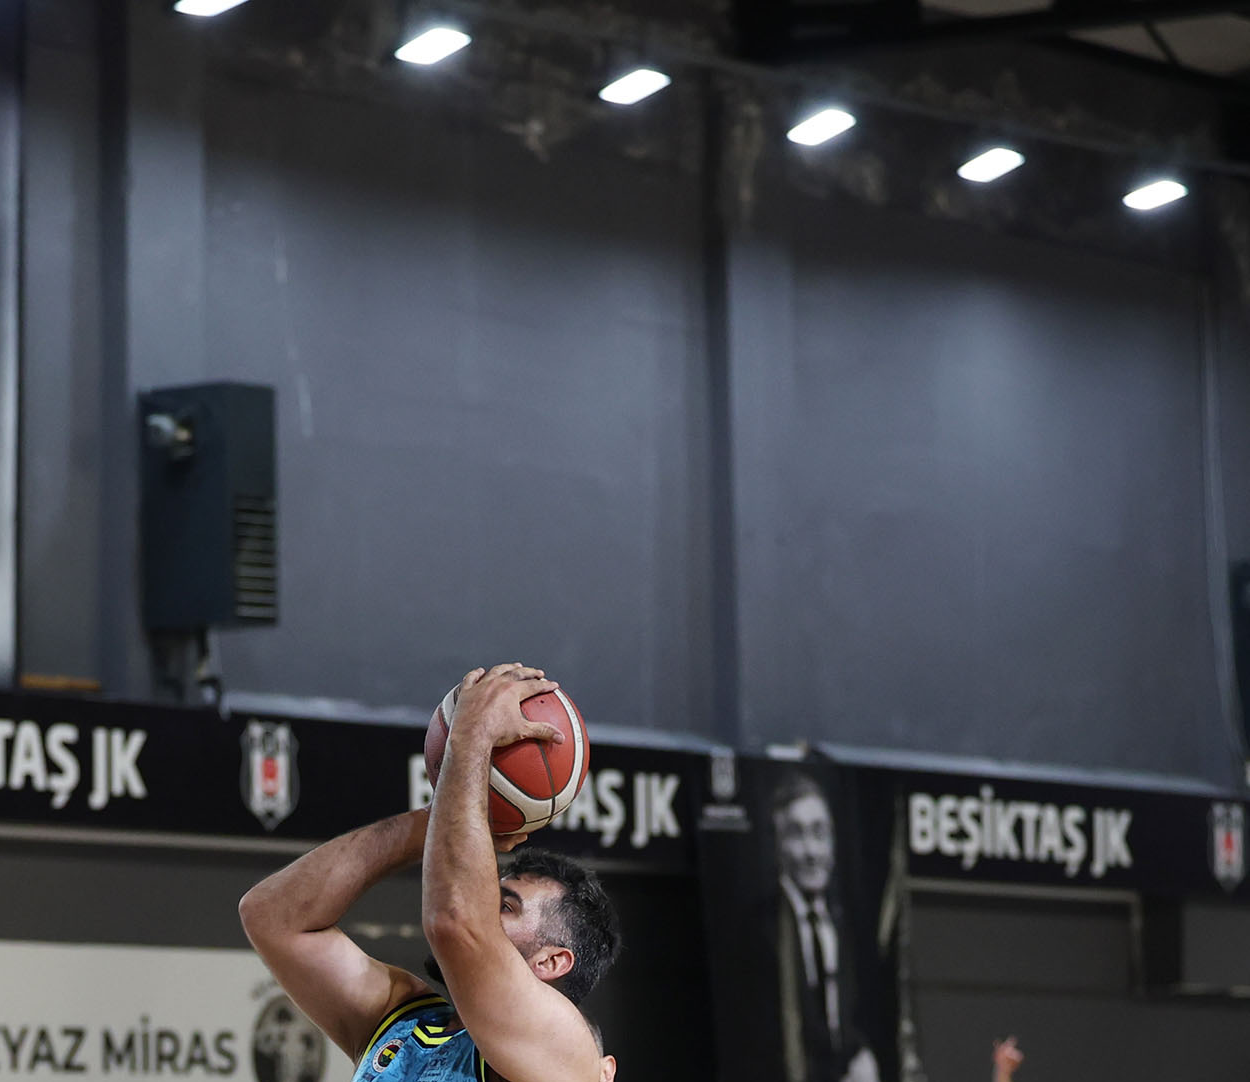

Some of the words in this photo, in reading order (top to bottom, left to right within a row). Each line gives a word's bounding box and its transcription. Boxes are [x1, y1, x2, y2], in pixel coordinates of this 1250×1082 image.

[89, 727, 147, 810] JK
[631, 771, 680, 847] JK
[909, 784, 1088, 878] BEŞİKTAŞ
[1090, 807, 1132, 878] JK
[102, 1012, 237, 1076] MİRAS
